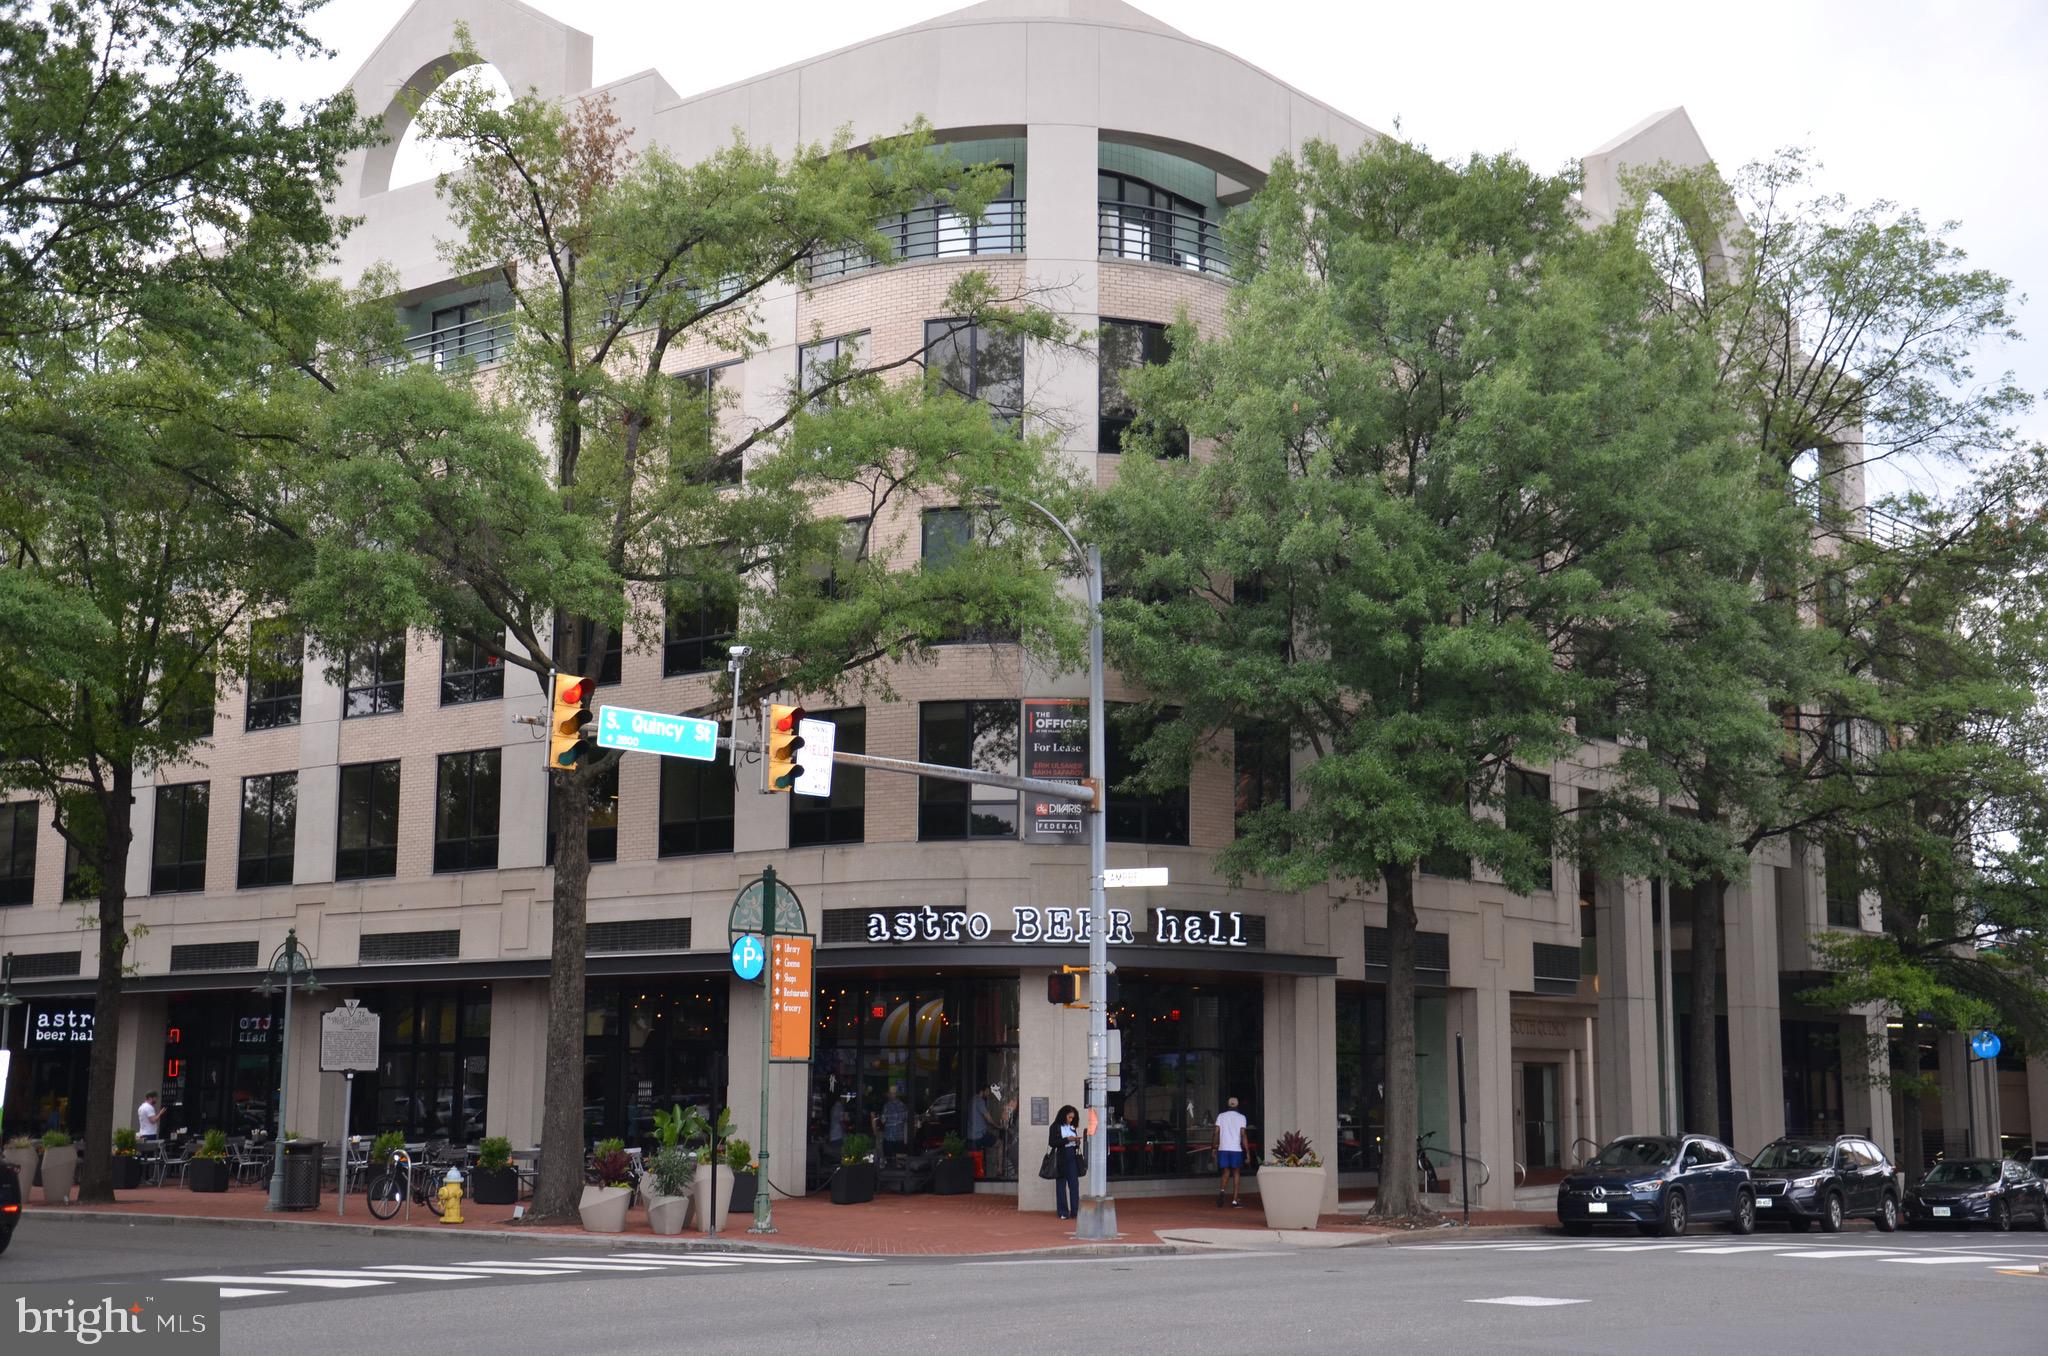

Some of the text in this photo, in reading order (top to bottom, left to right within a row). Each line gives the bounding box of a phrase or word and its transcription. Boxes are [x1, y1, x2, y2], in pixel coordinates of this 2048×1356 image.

[605, 711, 711, 743] S. Quincy St
[1035, 718, 1088, 729] OFFICES
[1033, 742, 1082, 753] For Lease
[1049, 803, 1082, 814] DIVARIS
[1038, 822, 1079, 830] FEDERAL
[864, 904, 992, 942] astro
[1155, 907, 1248, 947] hall
[743, 946, 756, 969] P
[37, 1010, 96, 1027] astr
[36, 1029, 94, 1041] beer hal
